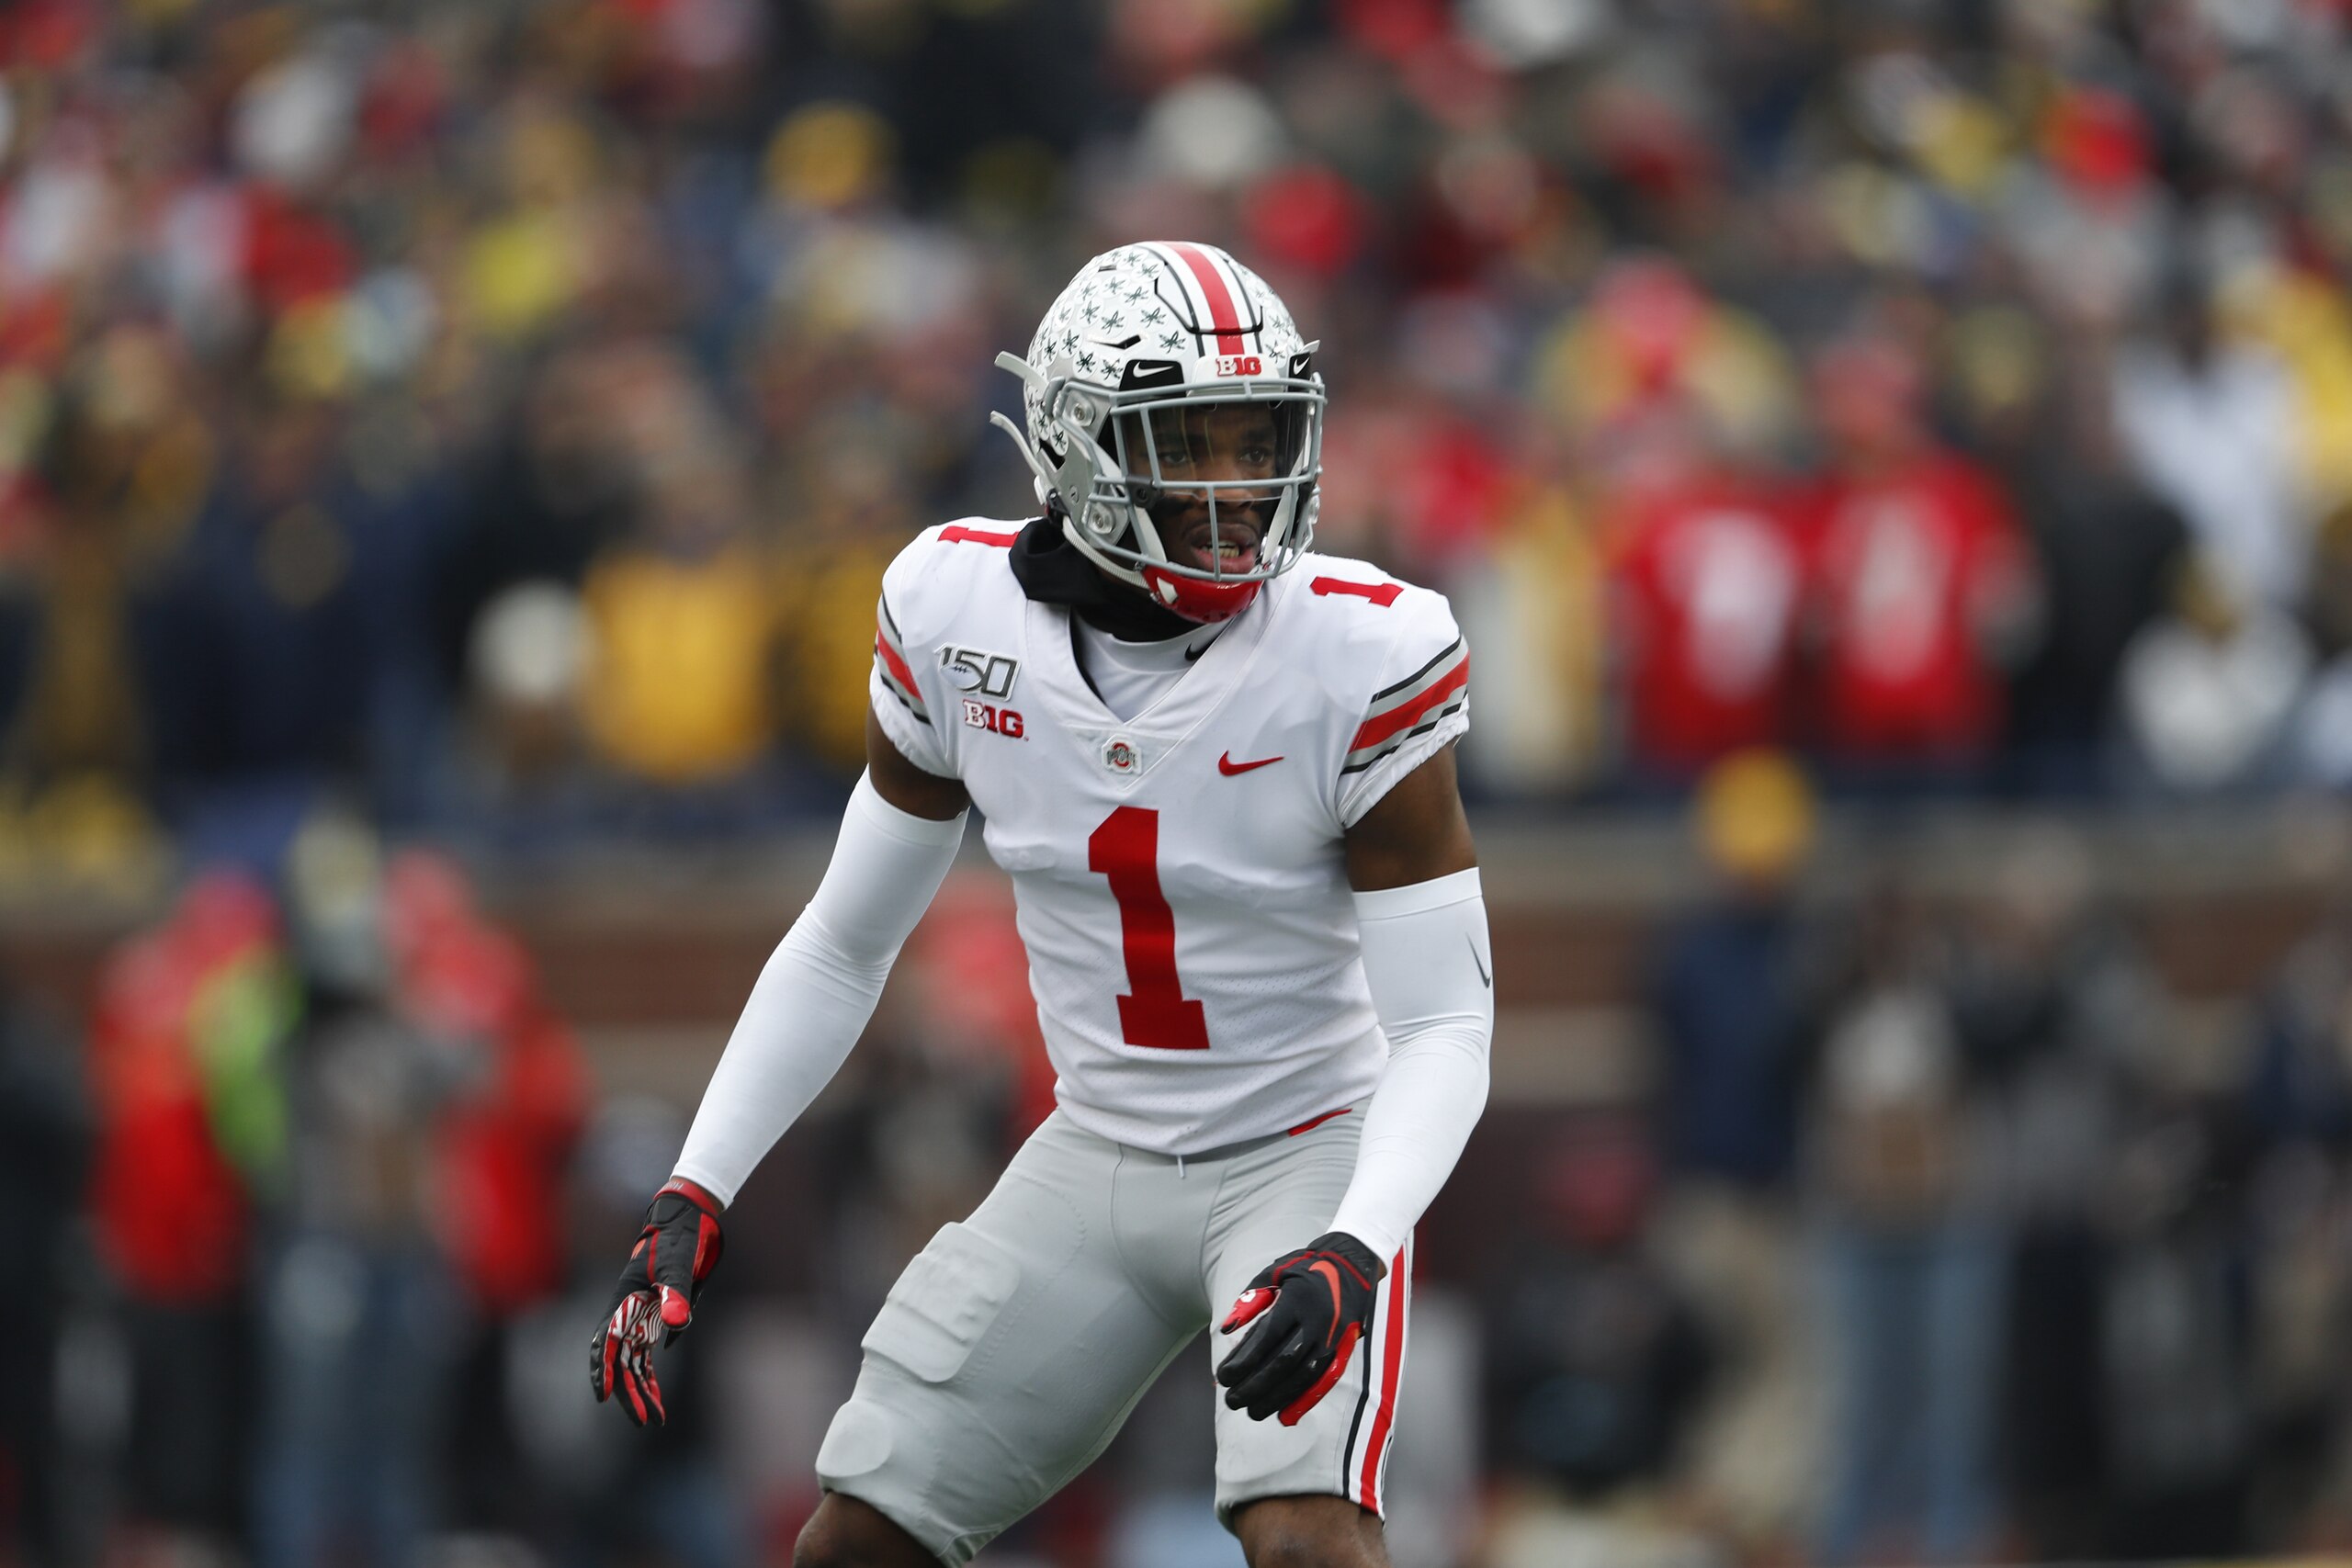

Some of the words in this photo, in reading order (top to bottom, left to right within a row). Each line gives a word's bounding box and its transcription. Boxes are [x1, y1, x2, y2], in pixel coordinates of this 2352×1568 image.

[937, 525, 1020, 547] 1
[1309, 576, 1405, 608] 1
[937, 645, 1019, 700] 150
[1088, 806, 1210, 1050] 1
